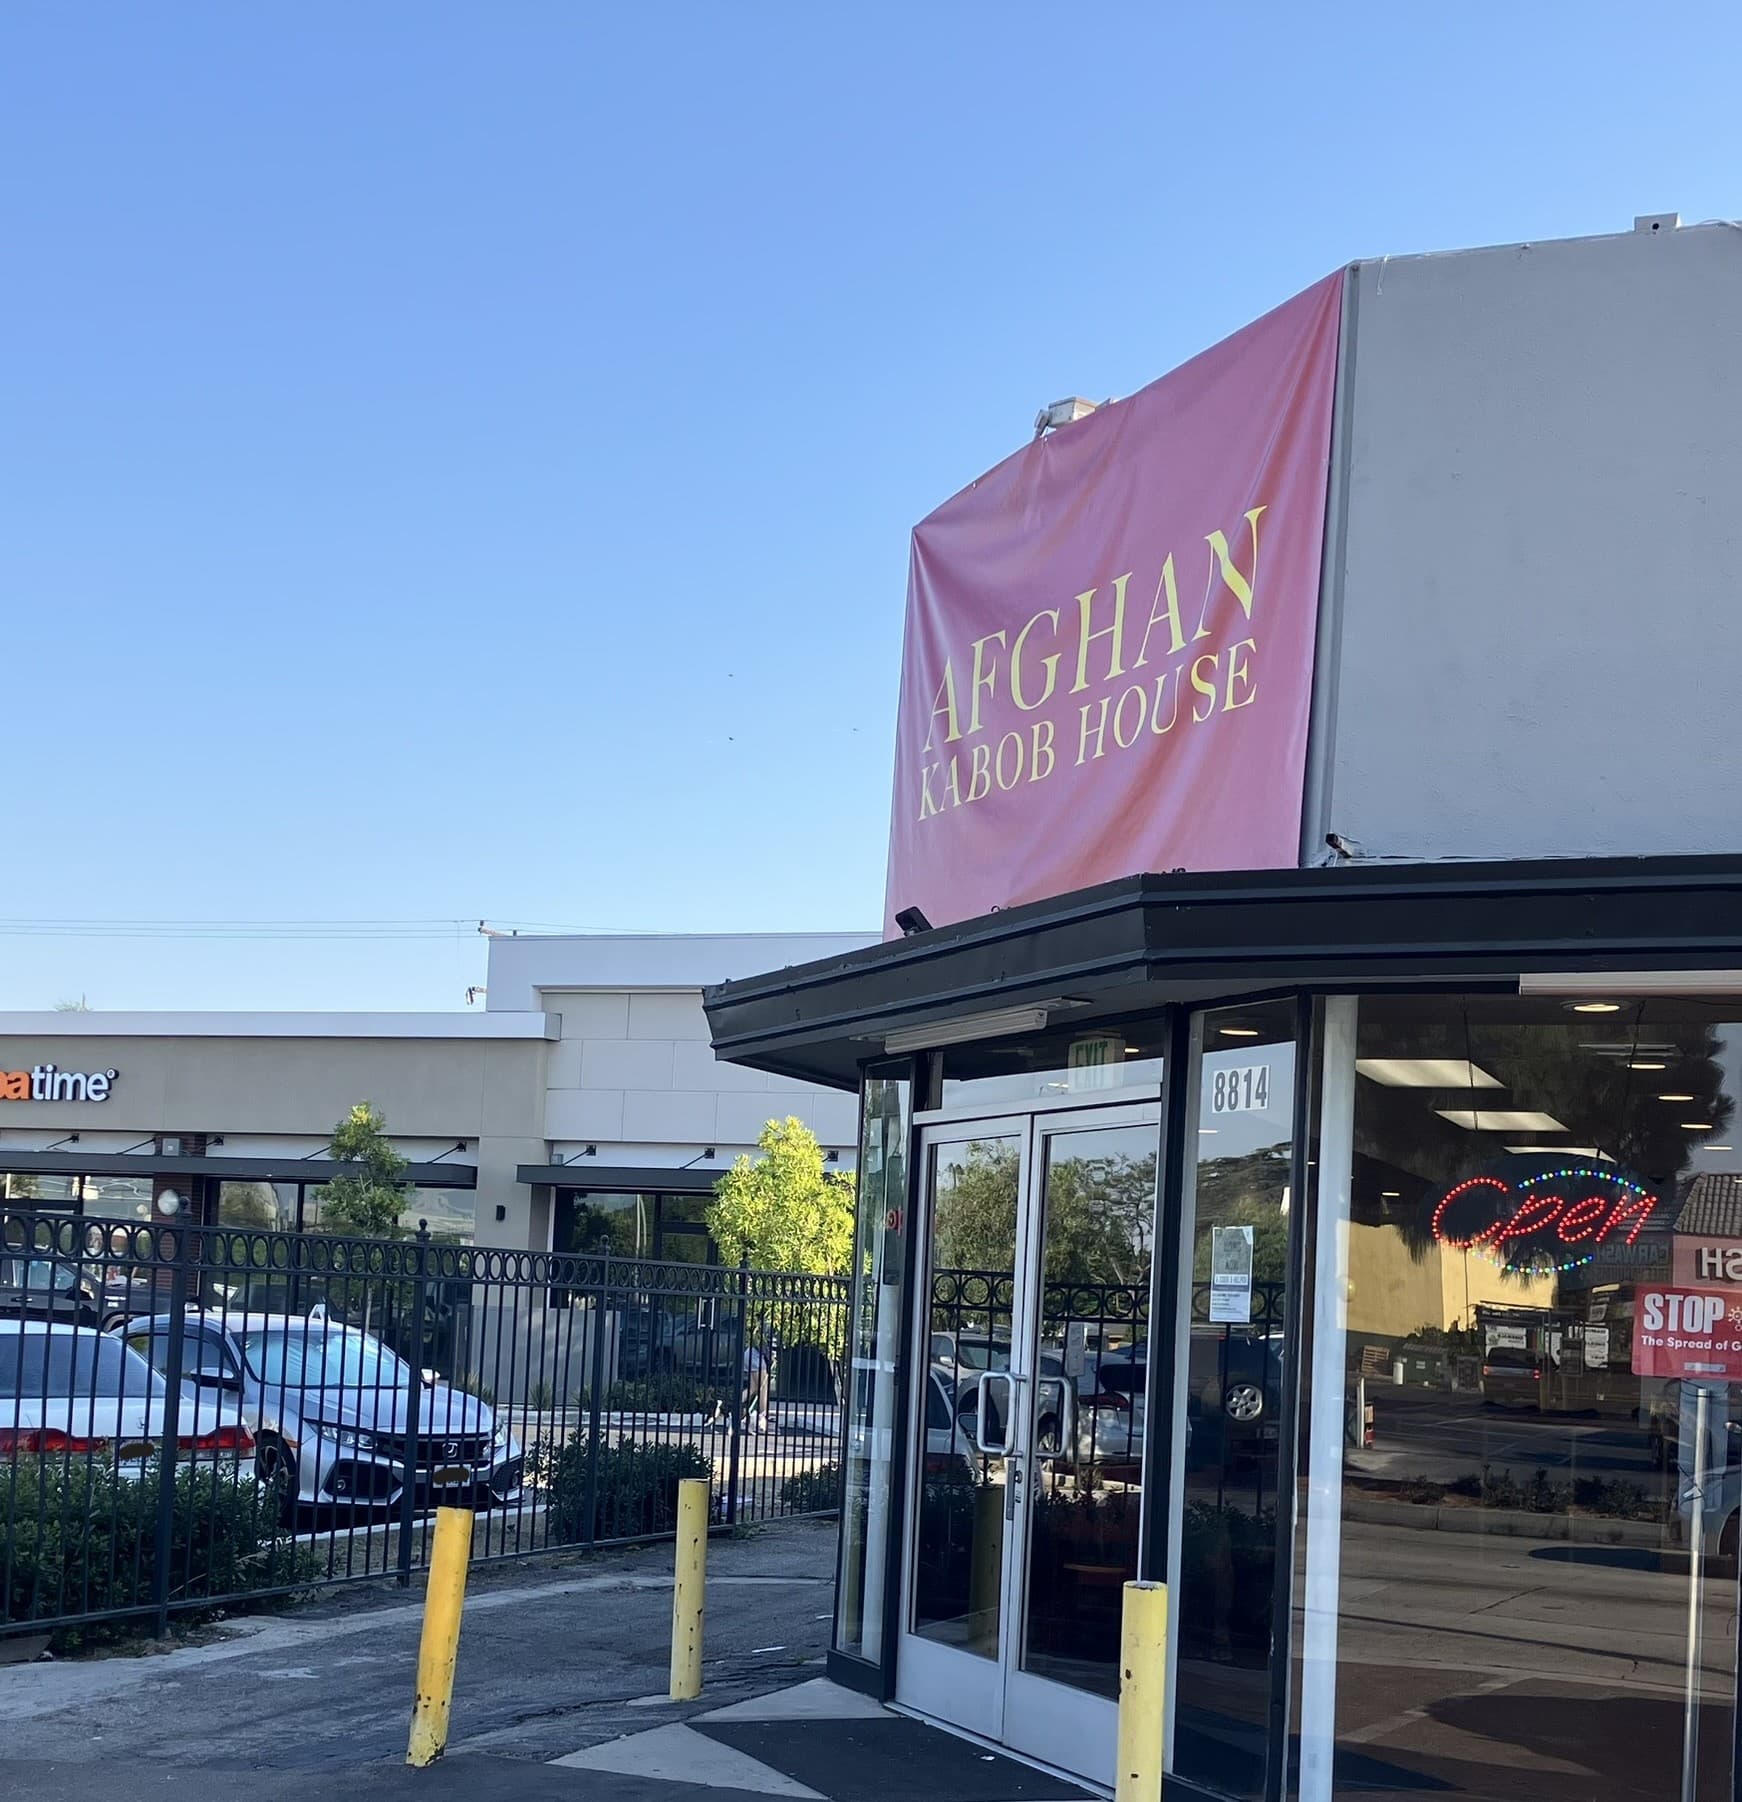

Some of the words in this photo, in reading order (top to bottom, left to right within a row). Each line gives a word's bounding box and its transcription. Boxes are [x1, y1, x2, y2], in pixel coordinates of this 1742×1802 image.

[921, 505, 1268, 753] AFGHAN
[917, 720, 1056, 821] KABOB
[1074, 638, 1258, 766] HOUSE
[1214, 1067, 1267, 1112] 8814
[1432, 1177, 1657, 1249] Open
[1643, 1293, 1725, 1333] STOP
[1641, 1335, 1663, 1346] The
[1667, 1337, 1711, 1350] Spread
[1715, 1340, 1728, 1350] of
